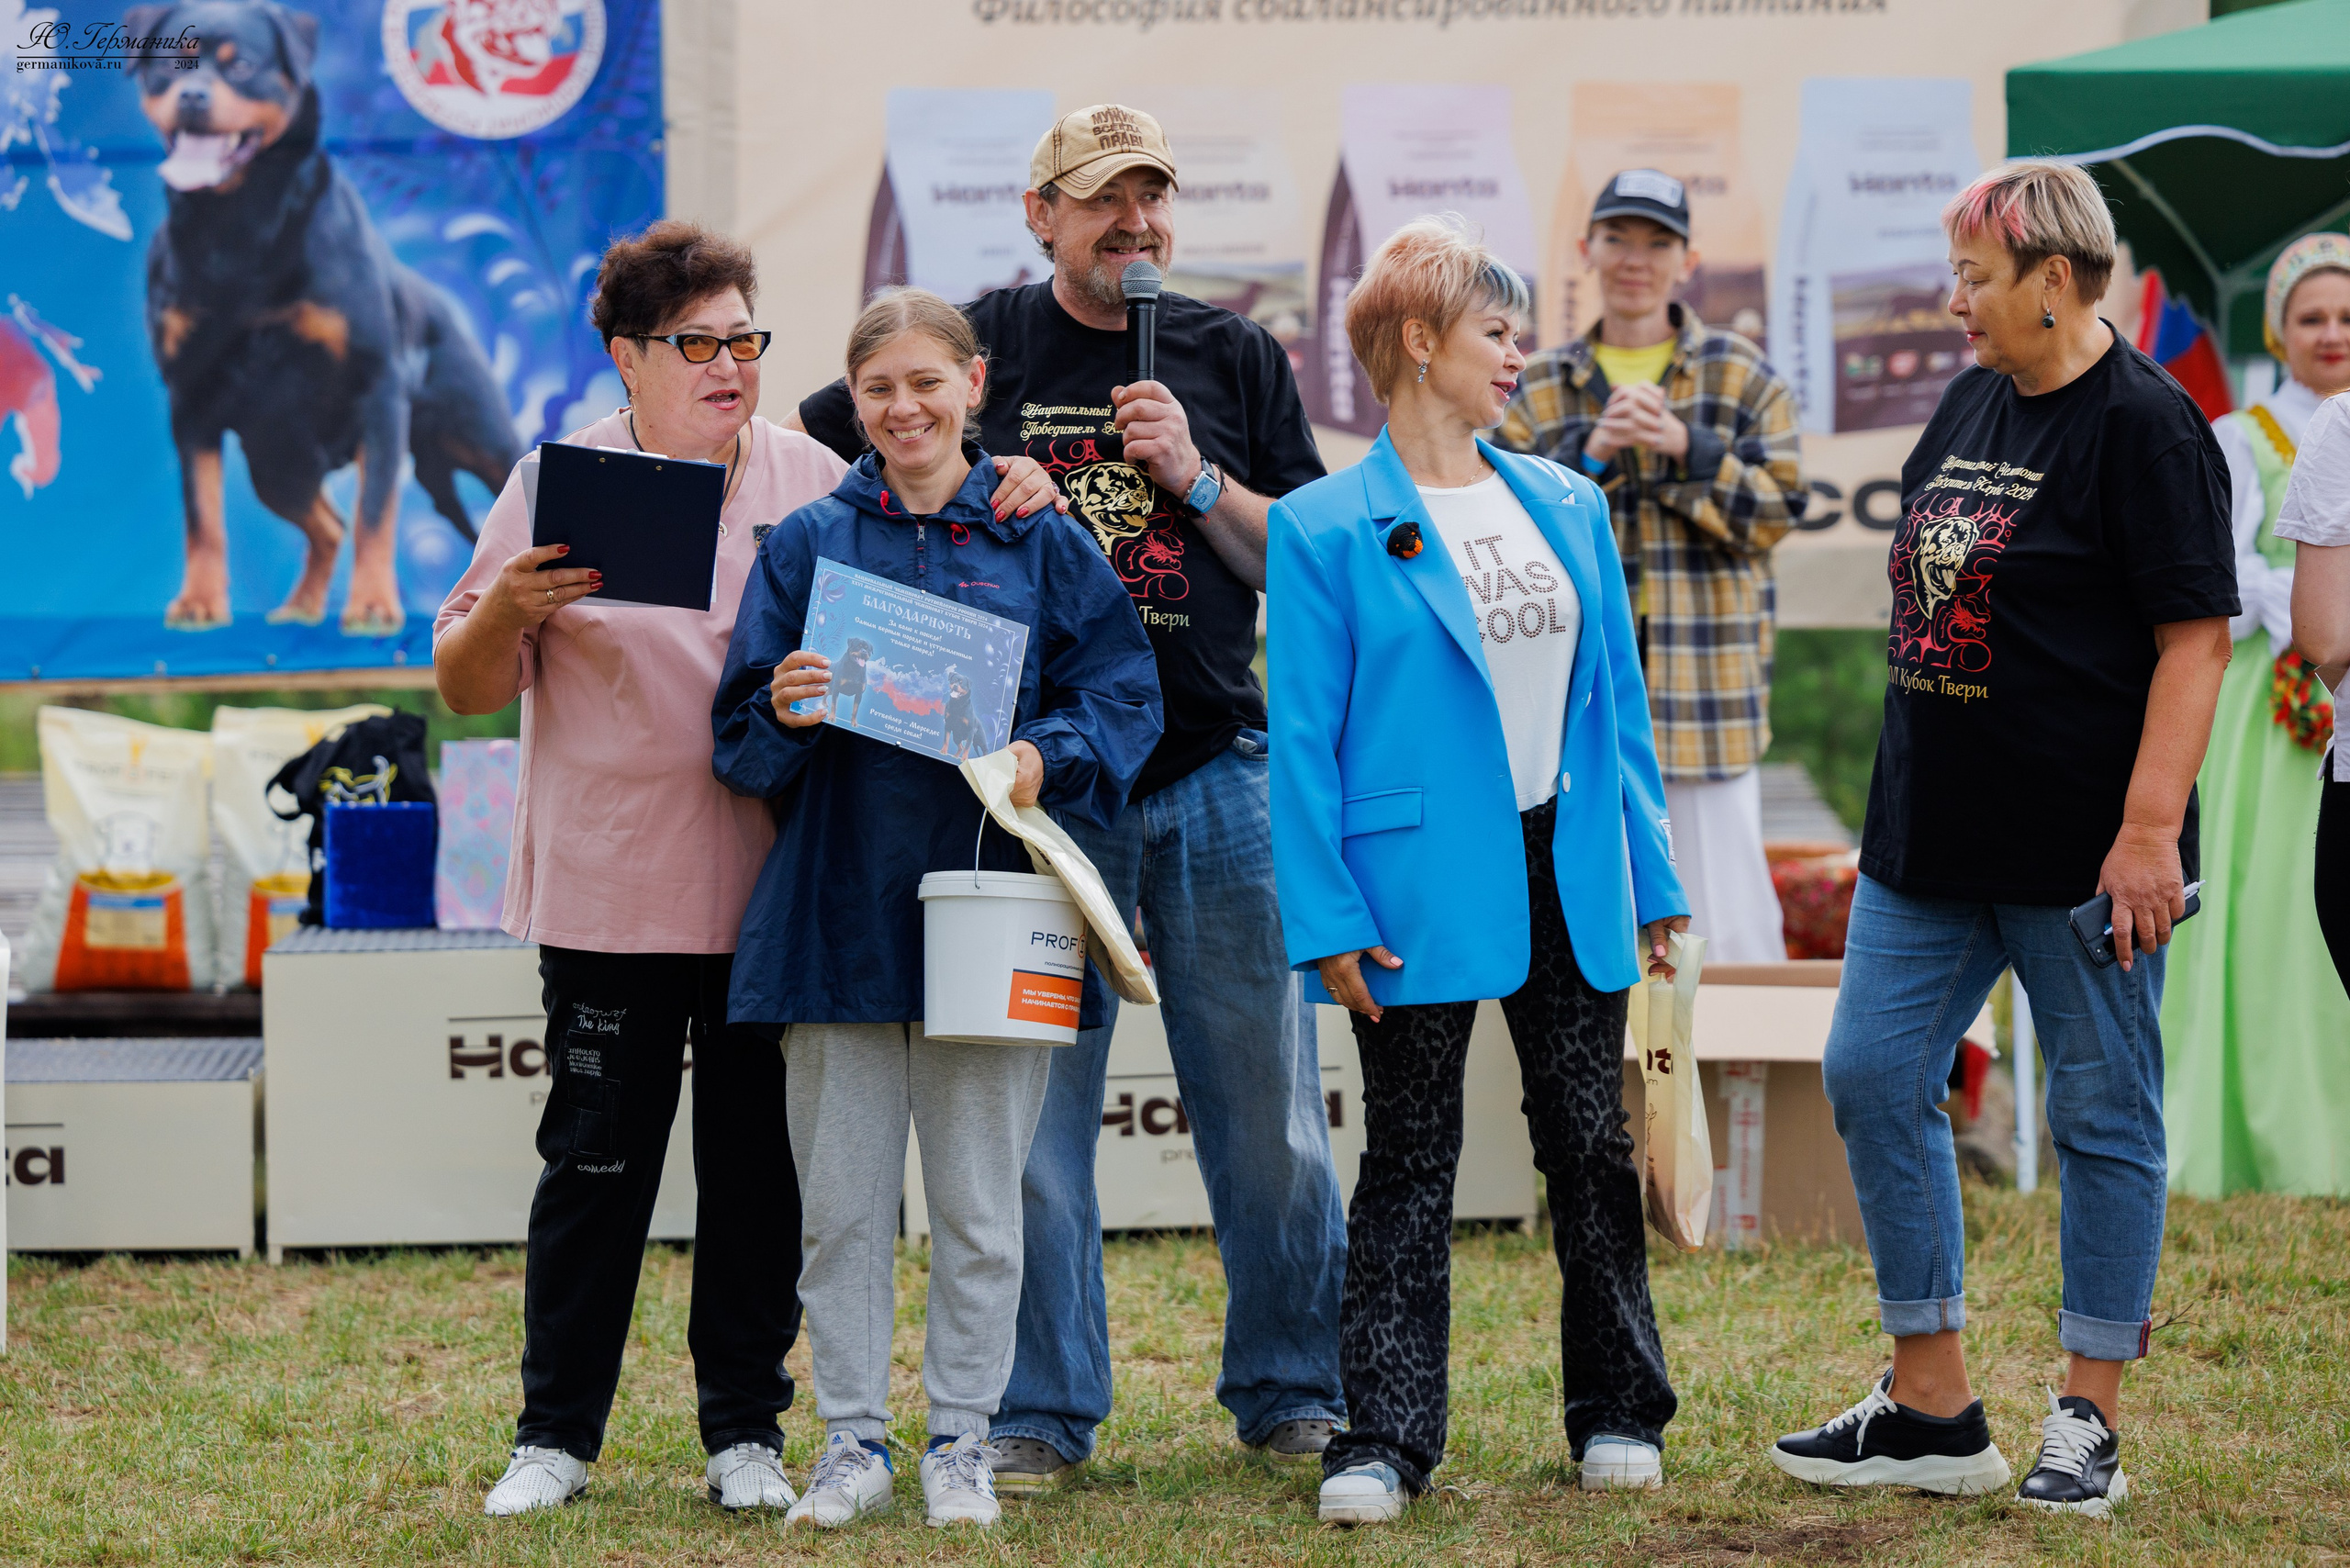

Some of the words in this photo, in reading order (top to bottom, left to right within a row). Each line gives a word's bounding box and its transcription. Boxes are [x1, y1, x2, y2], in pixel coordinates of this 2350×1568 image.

[1021, 402, 1113, 420] Национальный
[1020, 421, 1096, 442] Победитель
[1463, 534, 1504, 571] IT
[861, 593, 972, 641] БЛАГОДАРНОСТЬ
[1139, 606, 1190, 632] Твери
[1475, 598, 1566, 644] OOL
[854, 616, 877, 628] Самым
[877, 625, 901, 637] верным
[901, 633, 922, 644] породе
[888, 619, 897, 627] За
[898, 623, 912, 632] волю
[919, 629, 942, 642] победе!
[889, 637, 911, 649] только
[911, 644, 934, 657] вперед!
[1900, 668, 1935, 695] Кубок
[1938, 675, 1988, 703] Твери
[868, 708, 902, 724] Ротвейлер
[909, 721, 940, 737] Мерседес
[883, 722, 901, 733] среди
[903, 727, 923, 739] собак!
[1022, 998, 1064, 1009] НАЧИНАЕТСЯ
[577, 1014, 595, 1029] The
